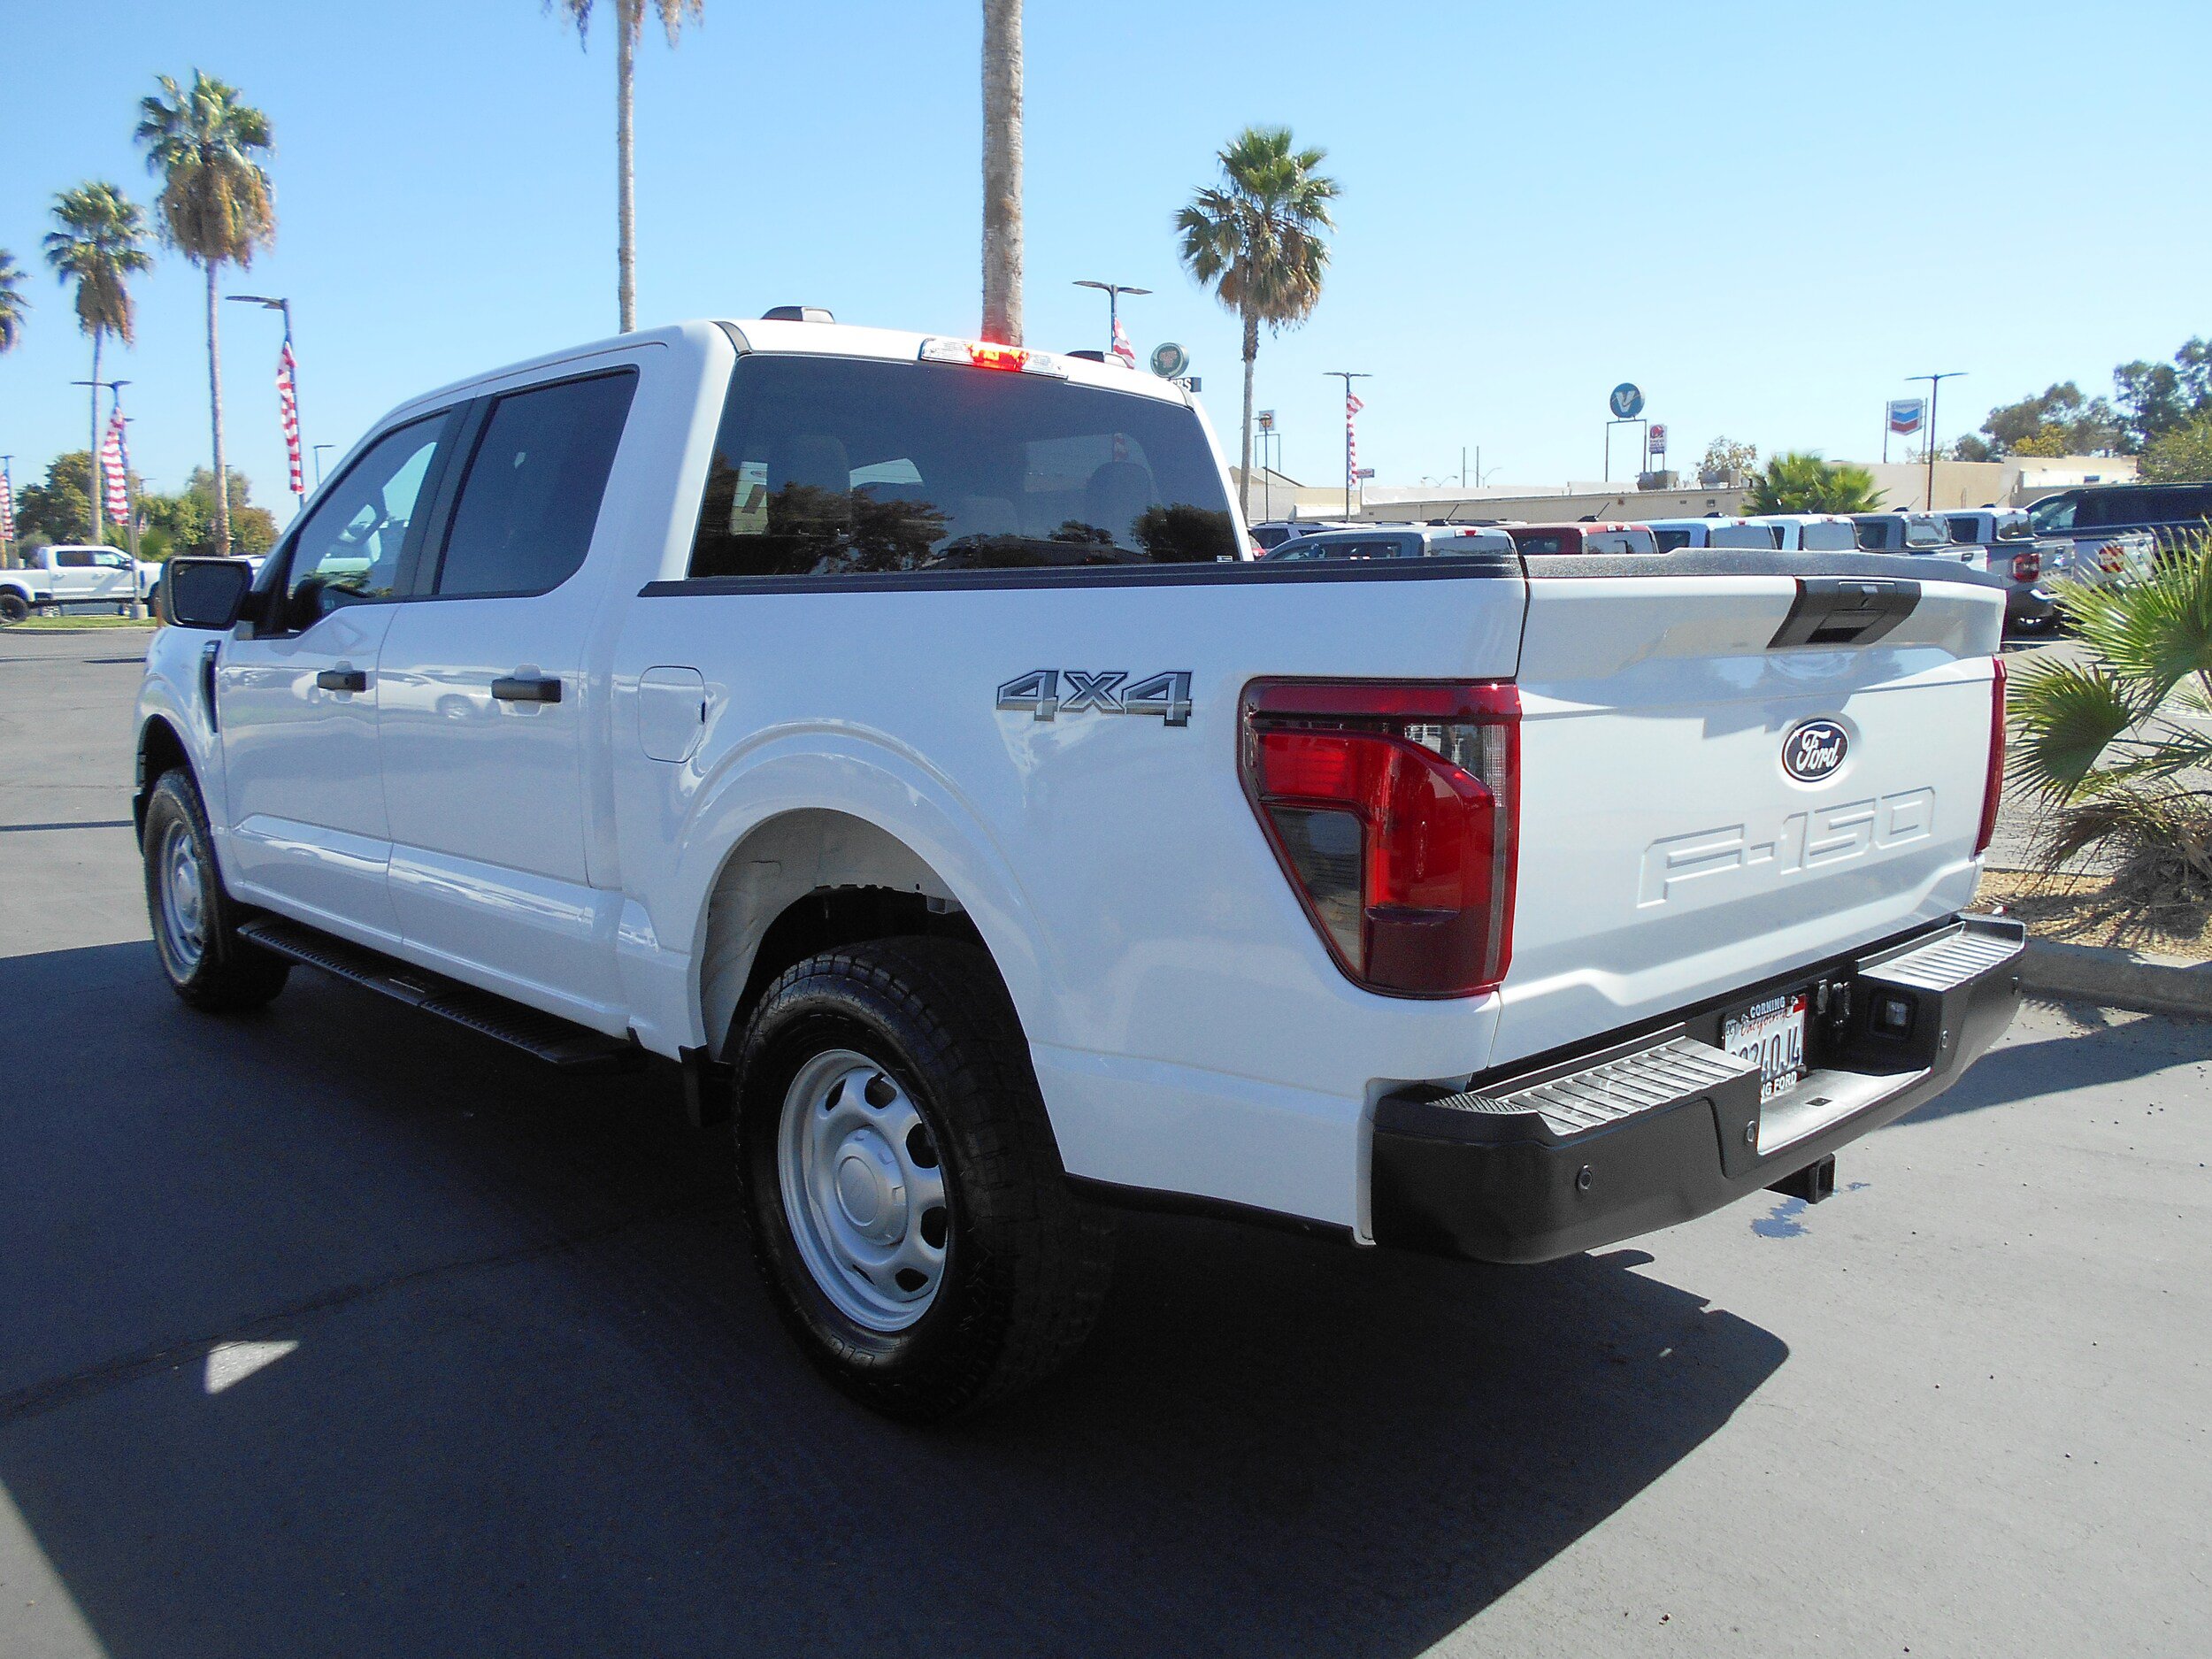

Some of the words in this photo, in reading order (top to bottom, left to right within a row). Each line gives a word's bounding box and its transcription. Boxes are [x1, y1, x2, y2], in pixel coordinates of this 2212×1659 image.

[1795, 727, 1841, 772] Ford
[1636, 785, 1936, 909] F-150
[1750, 995, 1786, 1018] CORNING
[1773, 1071, 1797, 1094] FORD
